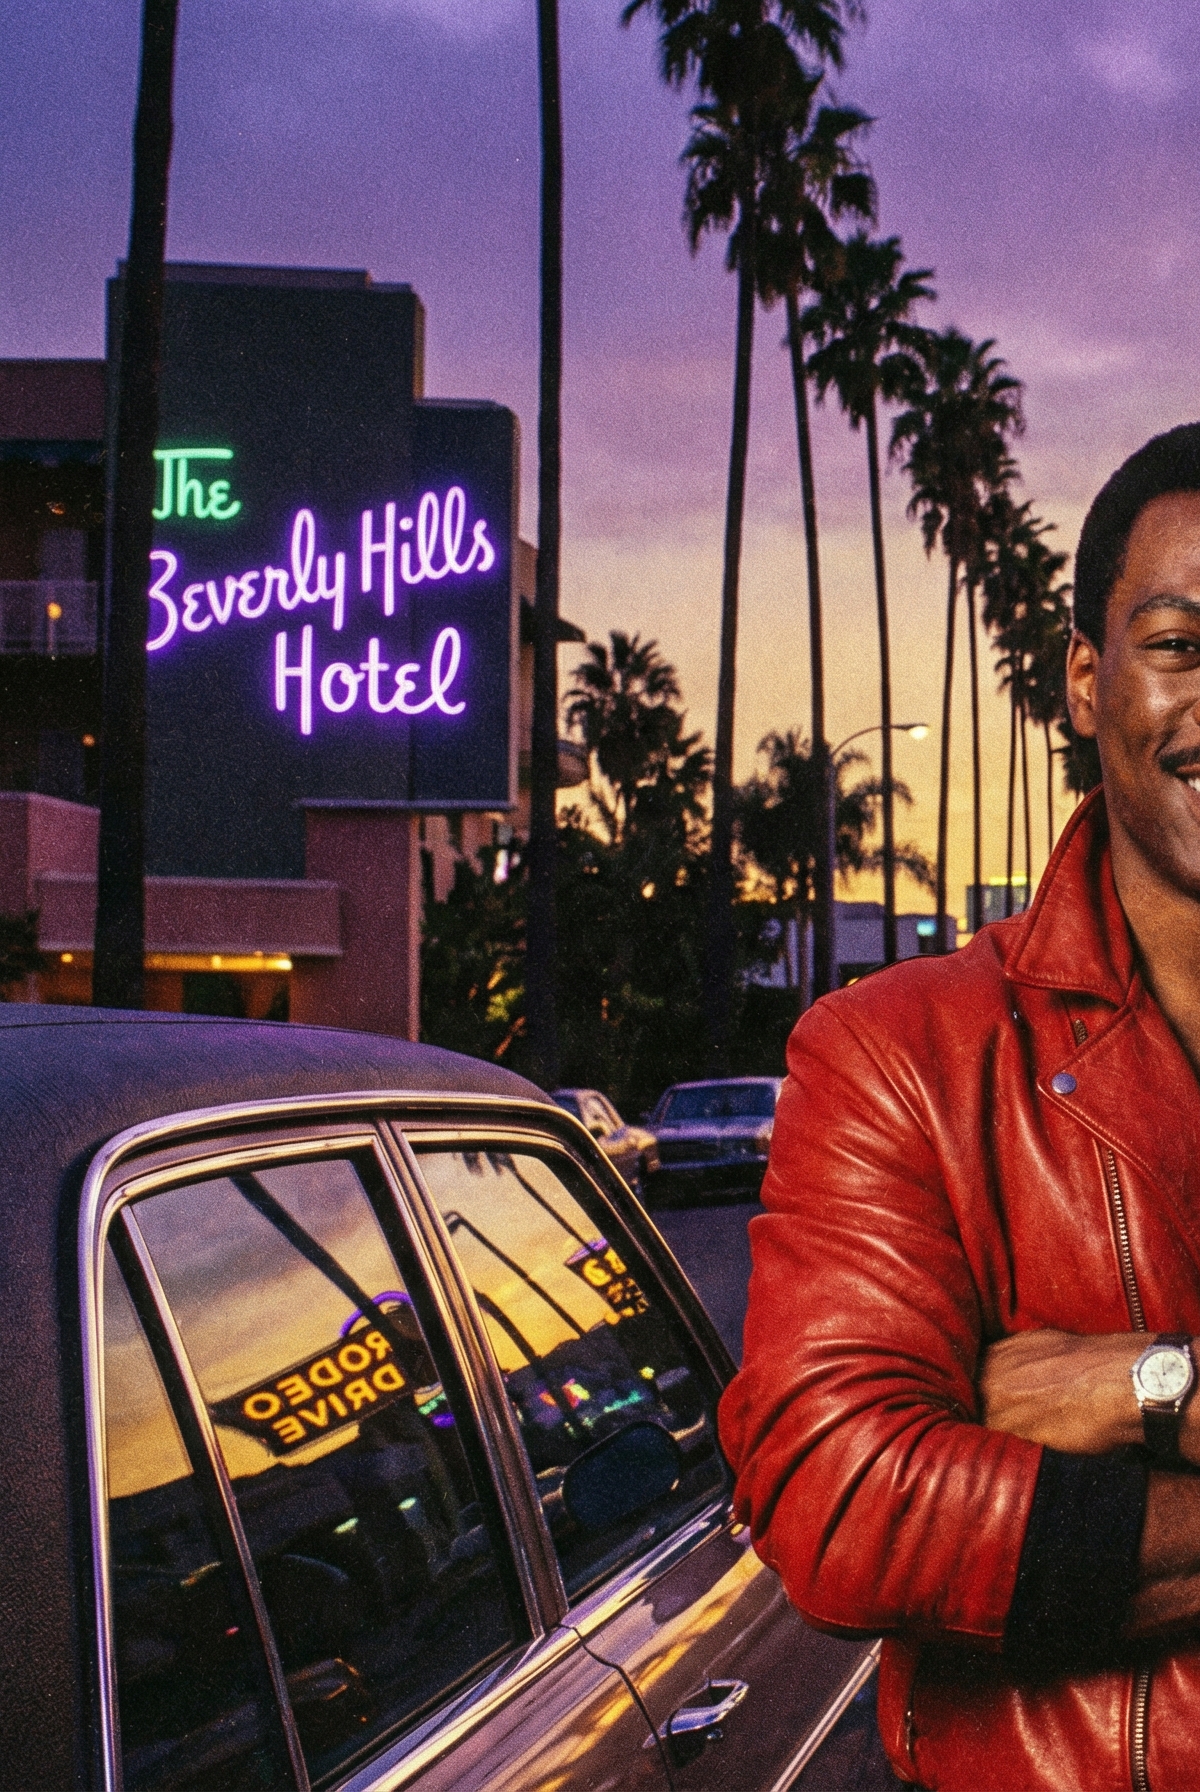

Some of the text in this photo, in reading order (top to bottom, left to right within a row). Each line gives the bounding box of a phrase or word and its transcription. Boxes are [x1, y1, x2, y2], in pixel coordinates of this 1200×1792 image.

[153, 448, 241, 519] The
[146, 485, 496, 651] Beverly Hills
[275, 624, 467, 735] Hotel
